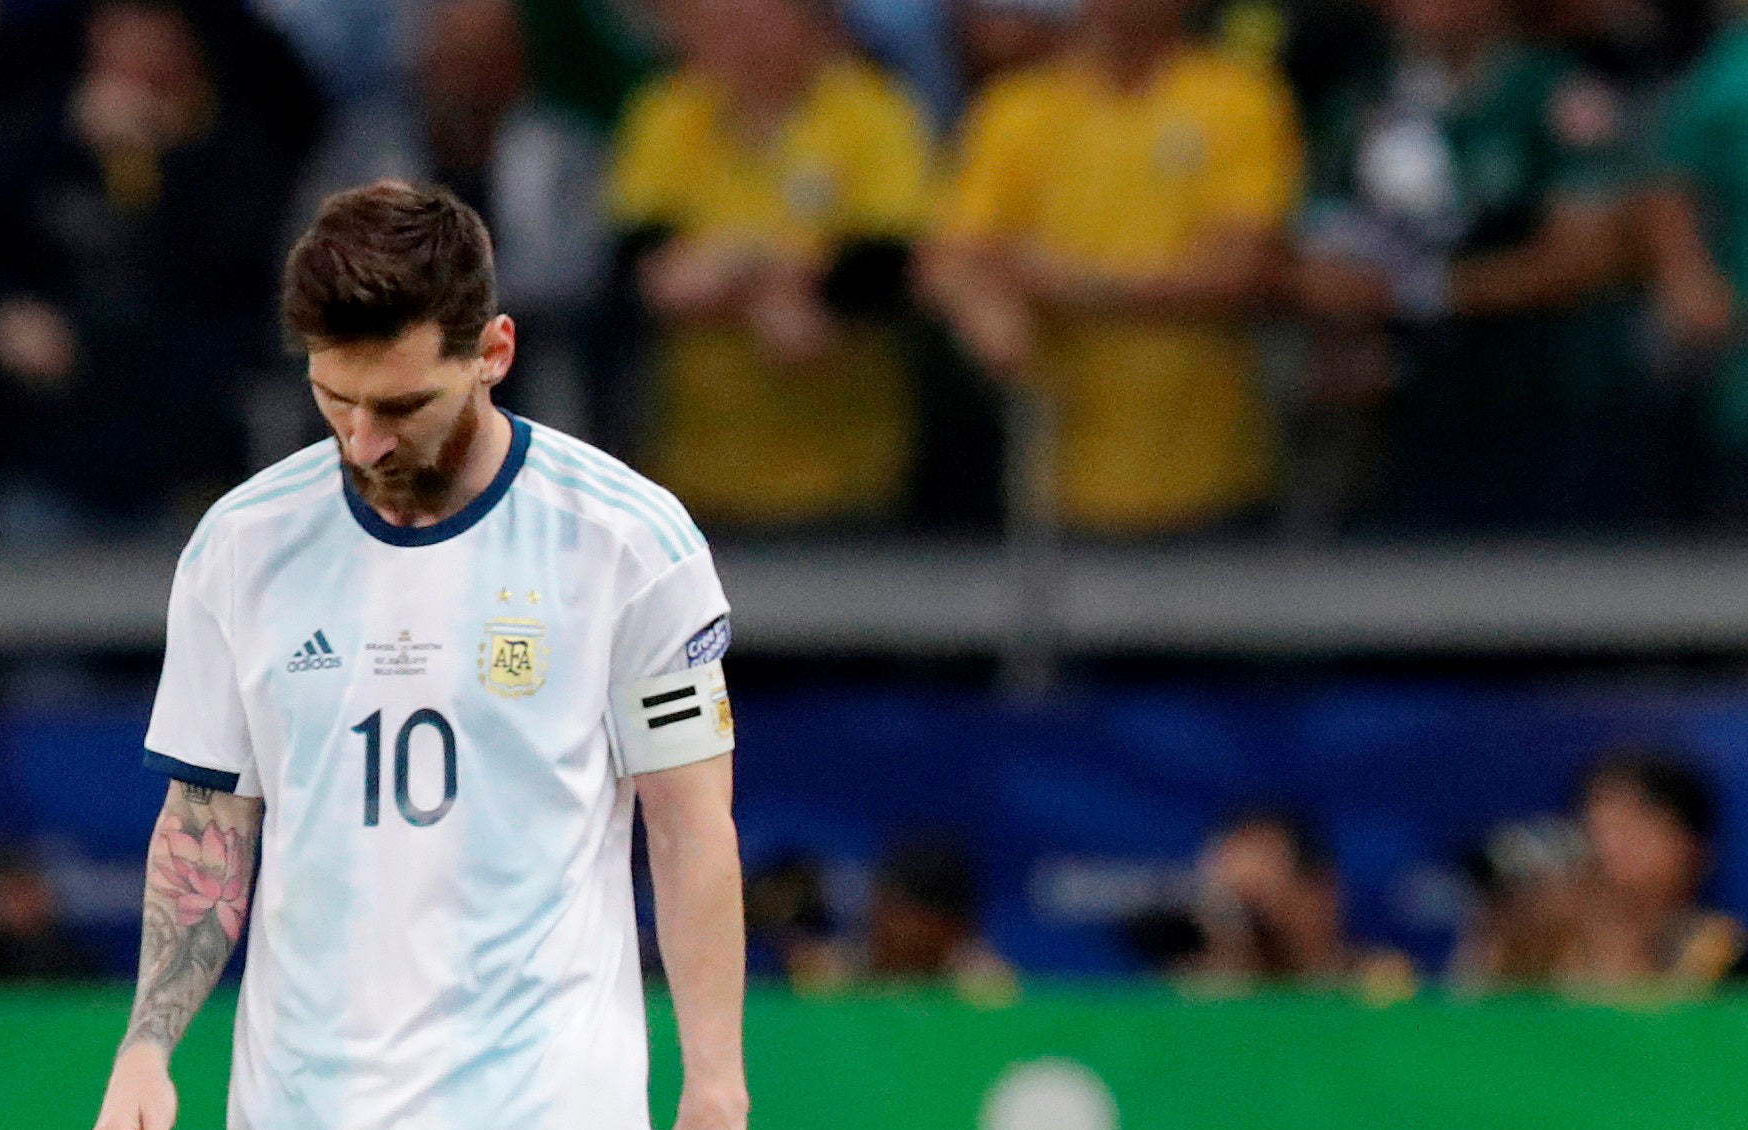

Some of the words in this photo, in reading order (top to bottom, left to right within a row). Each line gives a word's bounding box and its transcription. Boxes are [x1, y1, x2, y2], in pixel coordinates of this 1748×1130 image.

[286, 655, 343, 672] adidas
[493, 639, 531, 676] AFA
[351, 708, 457, 827] 10
